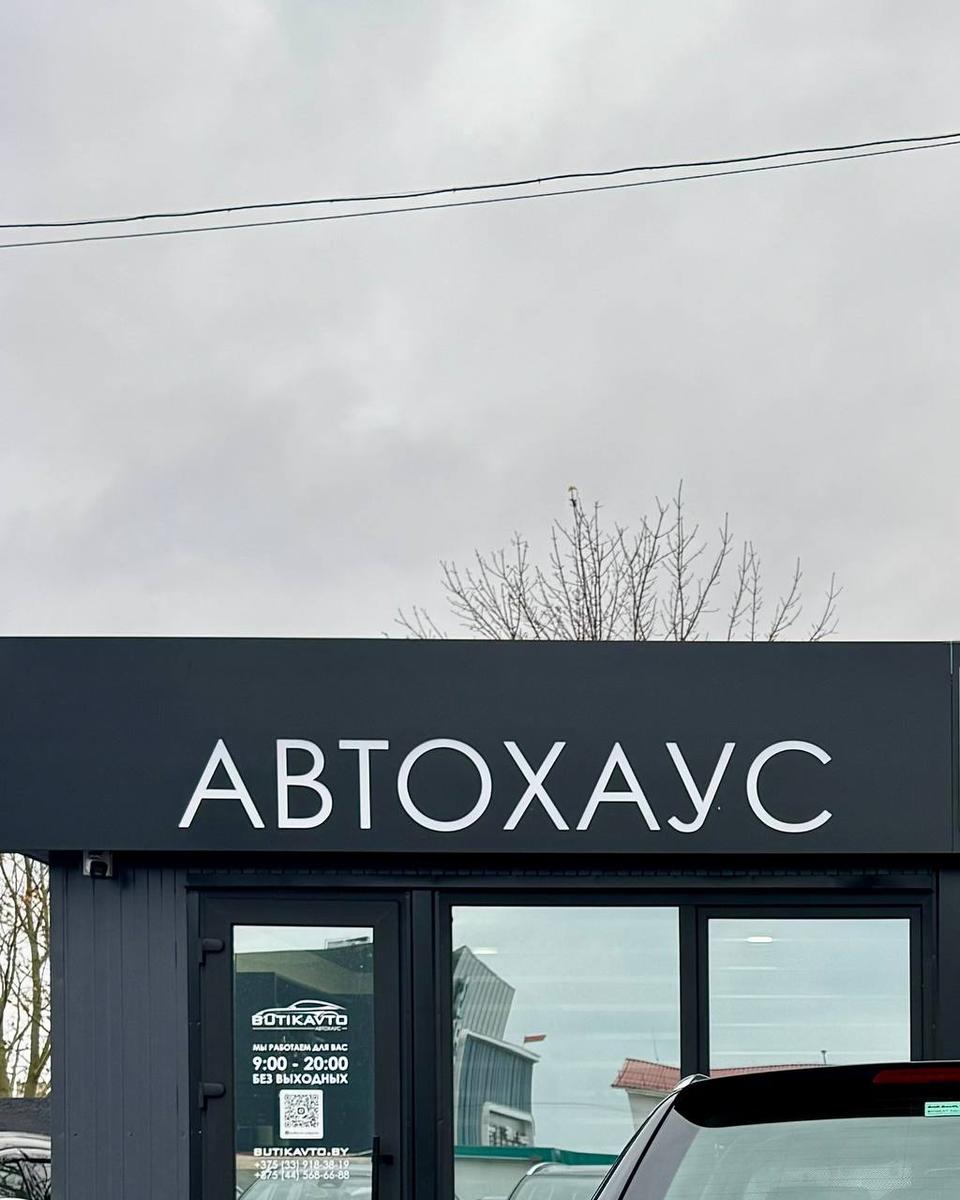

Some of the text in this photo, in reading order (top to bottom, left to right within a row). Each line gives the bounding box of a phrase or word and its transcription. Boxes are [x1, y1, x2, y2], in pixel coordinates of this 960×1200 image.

[178, 738, 834, 834] АВТОХАУС
[252, 1014, 348, 1026] BUTIKAVTO
[252, 1043, 348, 1052] МЫ РАБОТАЕМ ДЛЯ ВАС
[252, 1056, 287, 1071] 9:00
[303, 1056, 349, 1071] 20:00
[252, 1073, 349, 1085] БЕЗ ВЫХОДНЫХ
[253, 1147, 350, 1157] BUTIKAVTO.BY
[254, 1159, 350, 1170] +375 (33) 918-38-19
[281, 1170, 300, 1181] (44)
[303, 1170, 350, 1180] 568-66-88
